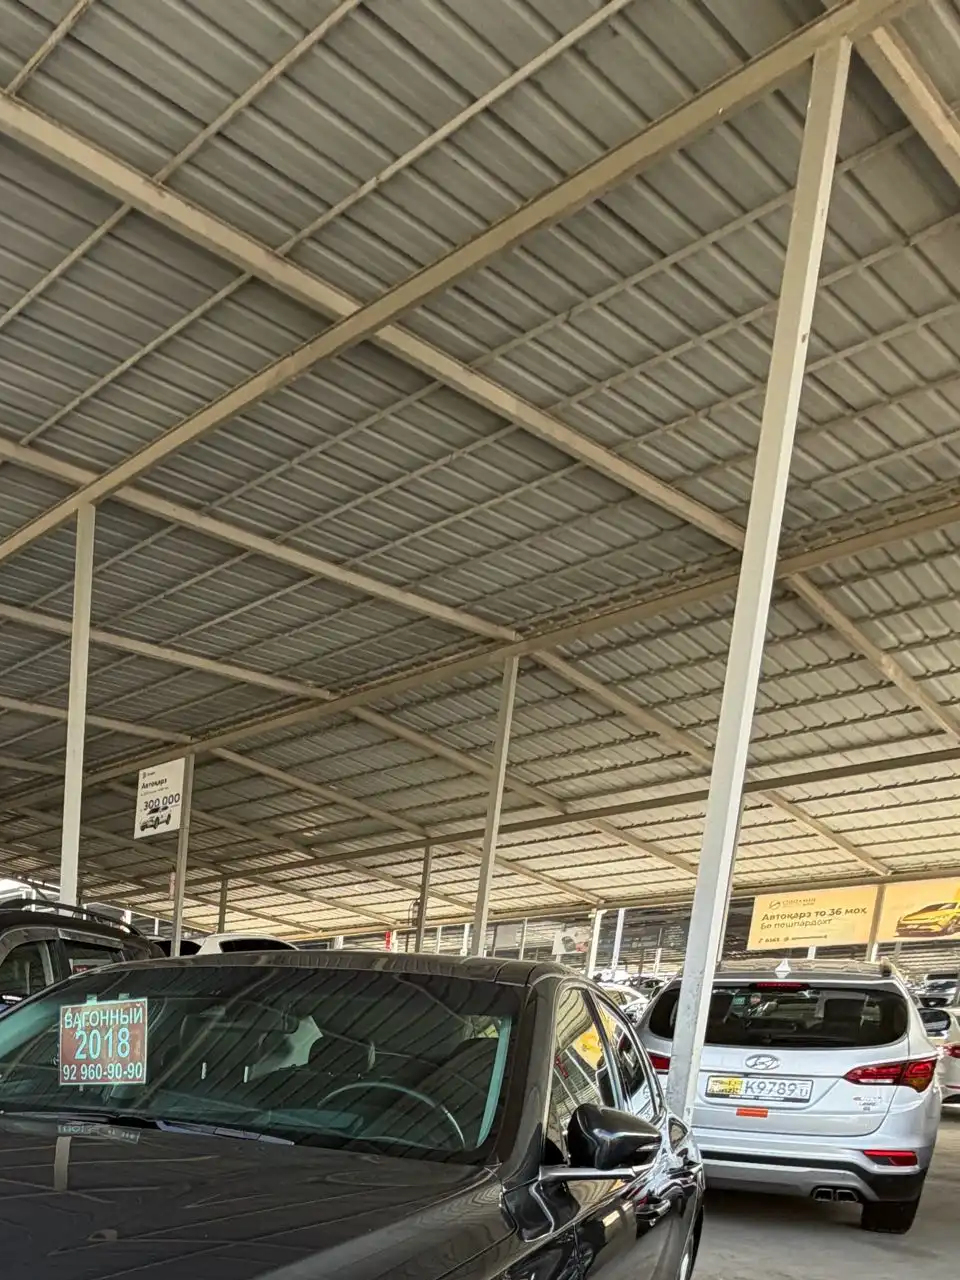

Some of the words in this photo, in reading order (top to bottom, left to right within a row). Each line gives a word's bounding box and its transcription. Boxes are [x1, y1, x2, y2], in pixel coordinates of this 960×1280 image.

[143, 798, 160, 811] 300
[162, 793, 180, 806] 000
[828, 908, 842, 916] 36
[64, 1003, 143, 1029] ВАГОННЫЙ
[74, 1027, 131, 1060] 2018
[63, 1064, 77, 1080] 92
[80, 1062, 142, 1080] 960-90-90
[744, 1080, 798, 1096] K9789
